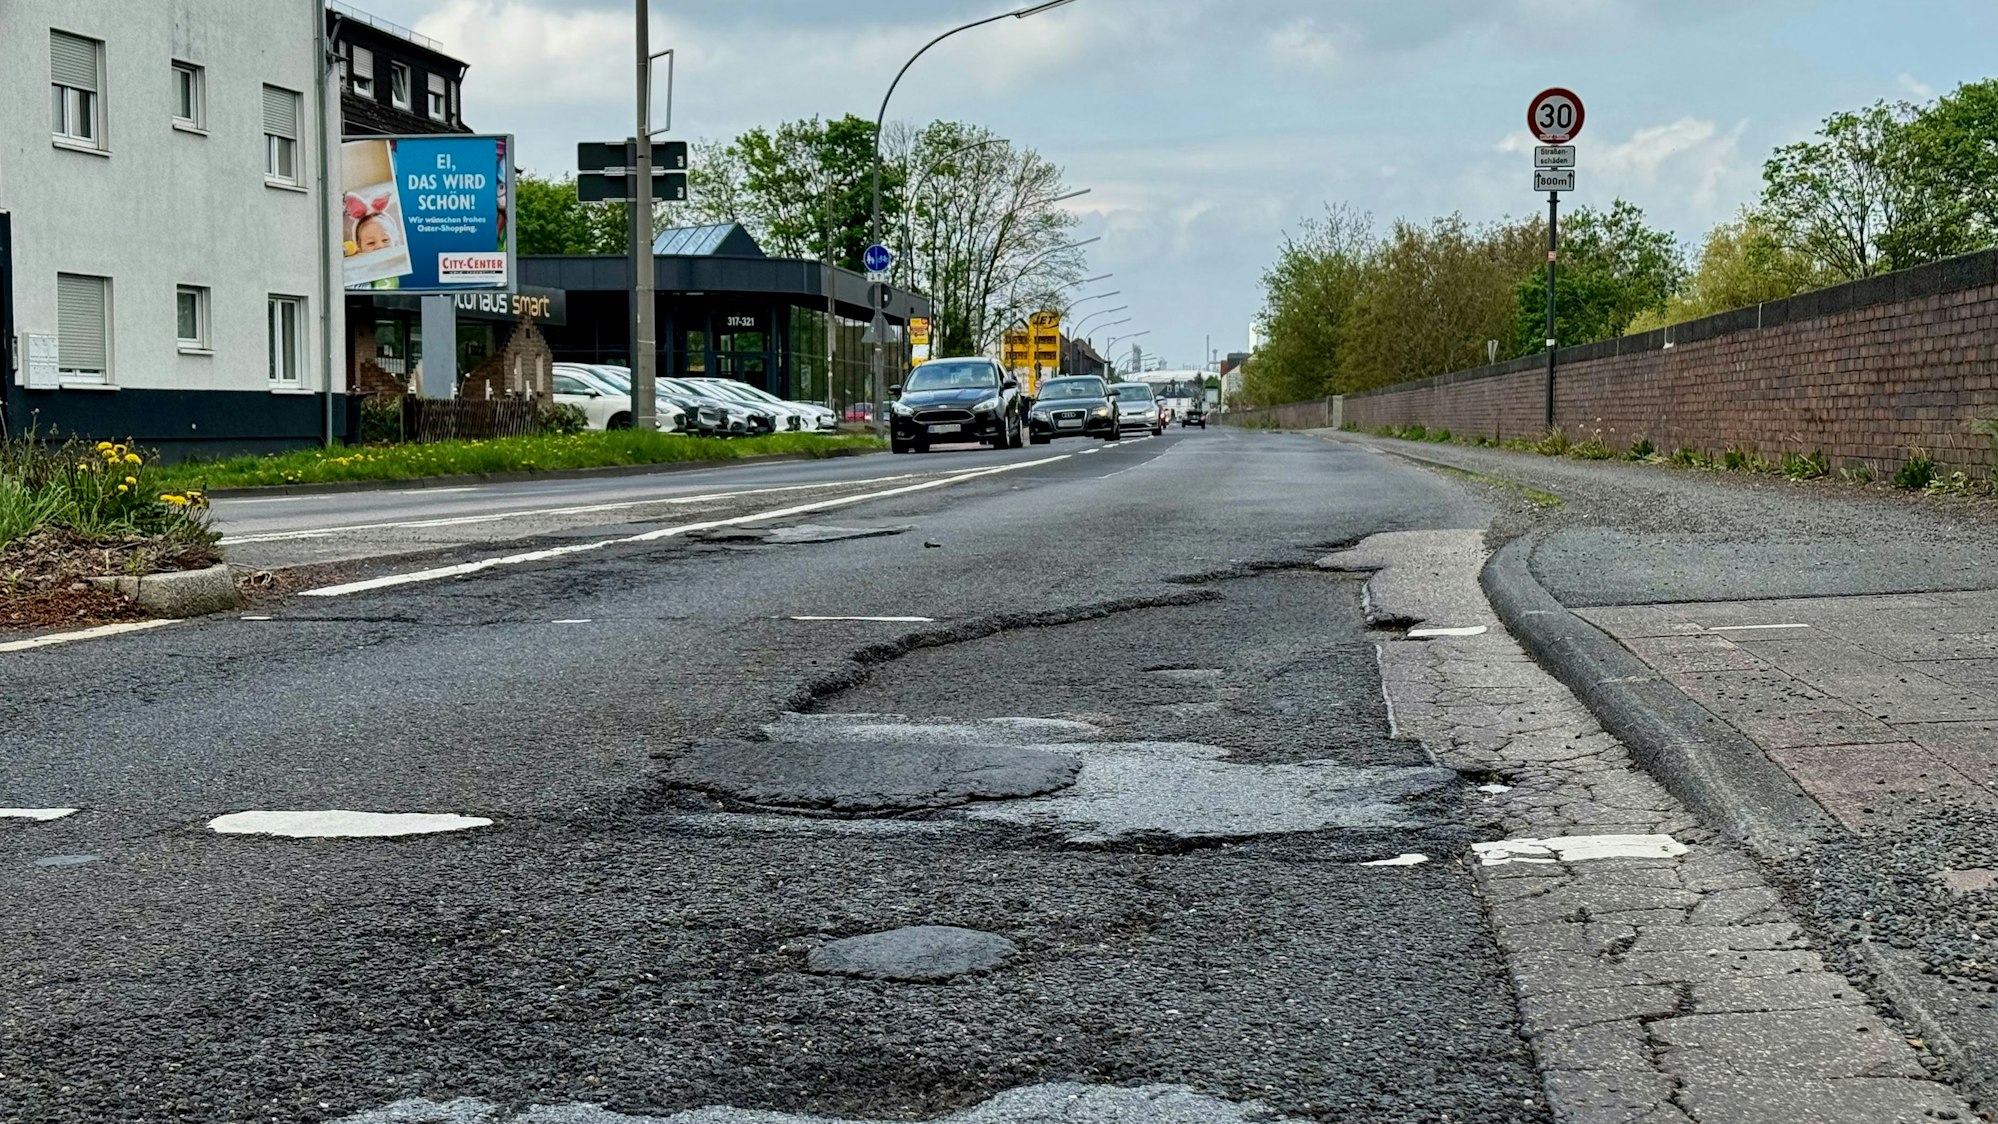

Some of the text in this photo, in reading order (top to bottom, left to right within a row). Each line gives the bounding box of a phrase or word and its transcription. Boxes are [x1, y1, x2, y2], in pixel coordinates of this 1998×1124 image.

[1540, 103, 1572, 128] 30
[437, 153, 456, 171] EI,
[1540, 157, 1567, 165] schäden
[408, 173, 486, 190] DAS WIRD
[1540, 177, 1567, 186] 800m
[418, 190, 476, 210] SCHÖN!
[408, 215, 487, 224] Wir wünschen frohes
[417, 224, 477, 233] Oster-Shopping.
[512, 295, 550, 318] smart
[727, 316, 755, 326] 317-321
